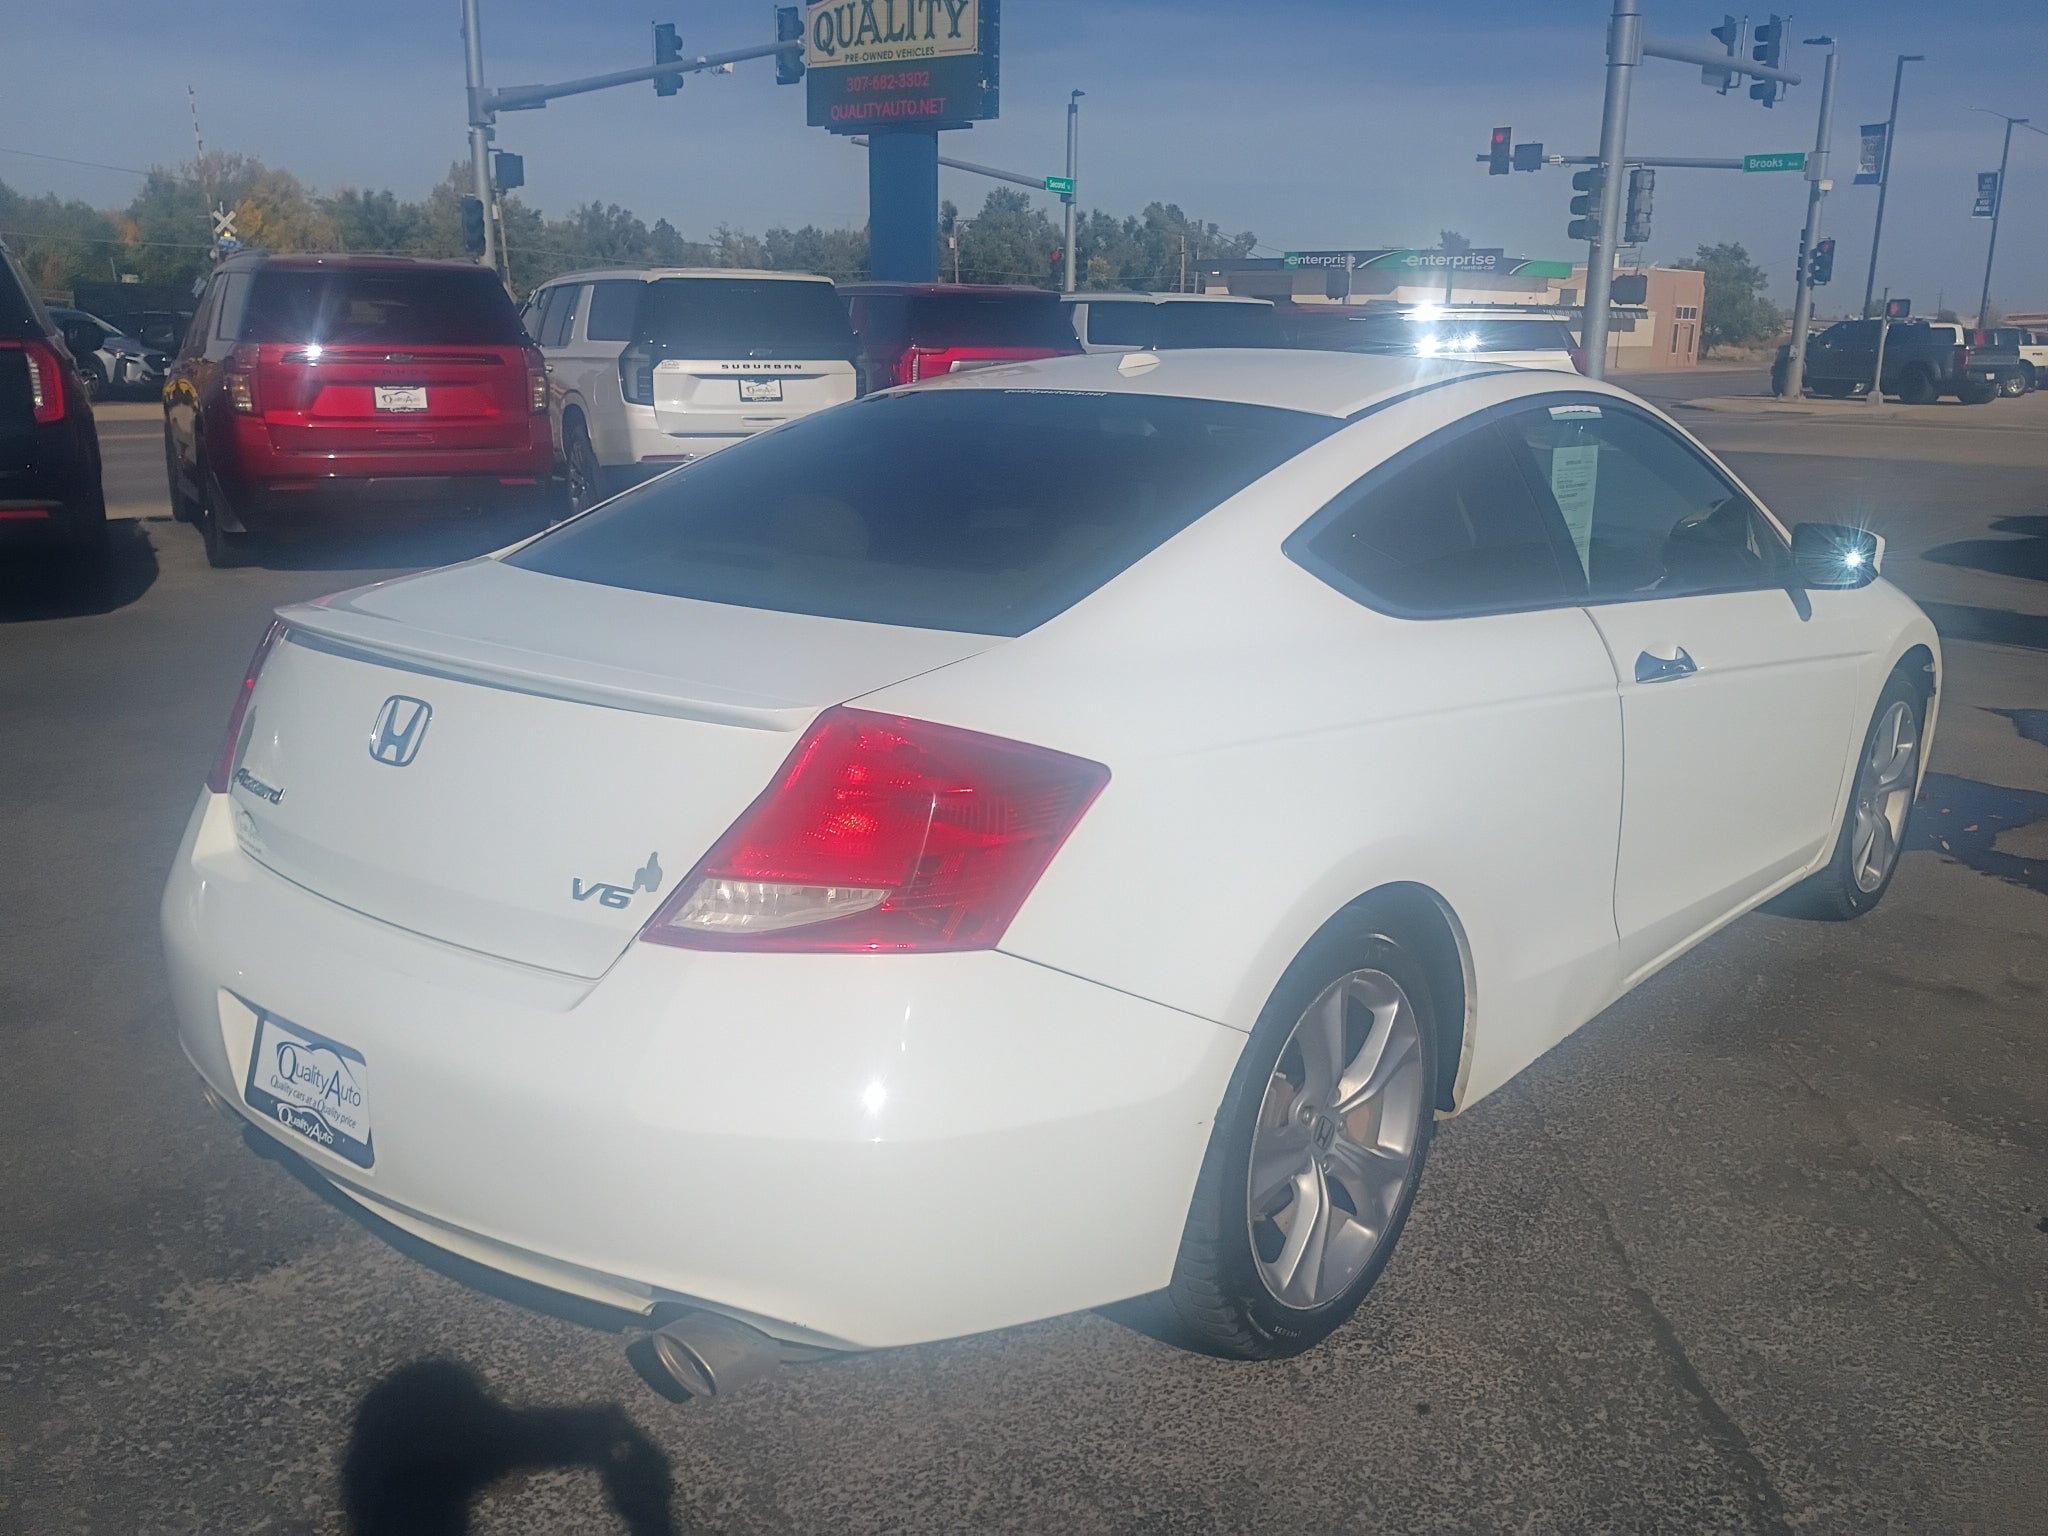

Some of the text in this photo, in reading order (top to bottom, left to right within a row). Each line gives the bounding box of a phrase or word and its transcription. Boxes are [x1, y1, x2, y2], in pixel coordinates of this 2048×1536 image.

[812, 0, 970, 57] QUALITY
[844, 47, 935, 63] PRE-OWNED VEHICLES
[846, 71, 930, 92] 307-682-3302
[830, 98, 946, 121] QUALITYAUTO.NET
[1749, 157, 1784, 169] Brooks
[1285, 253, 1356, 267] enterprise
[1402, 252, 1496, 269] enterprise
[572, 877, 635, 910] V6
[270, 1074, 293, 1096] Quality
[292, 1089, 306, 1103] cars
[316, 1099, 341, 1123] Quality
[340, 1111, 357, 1129] price
